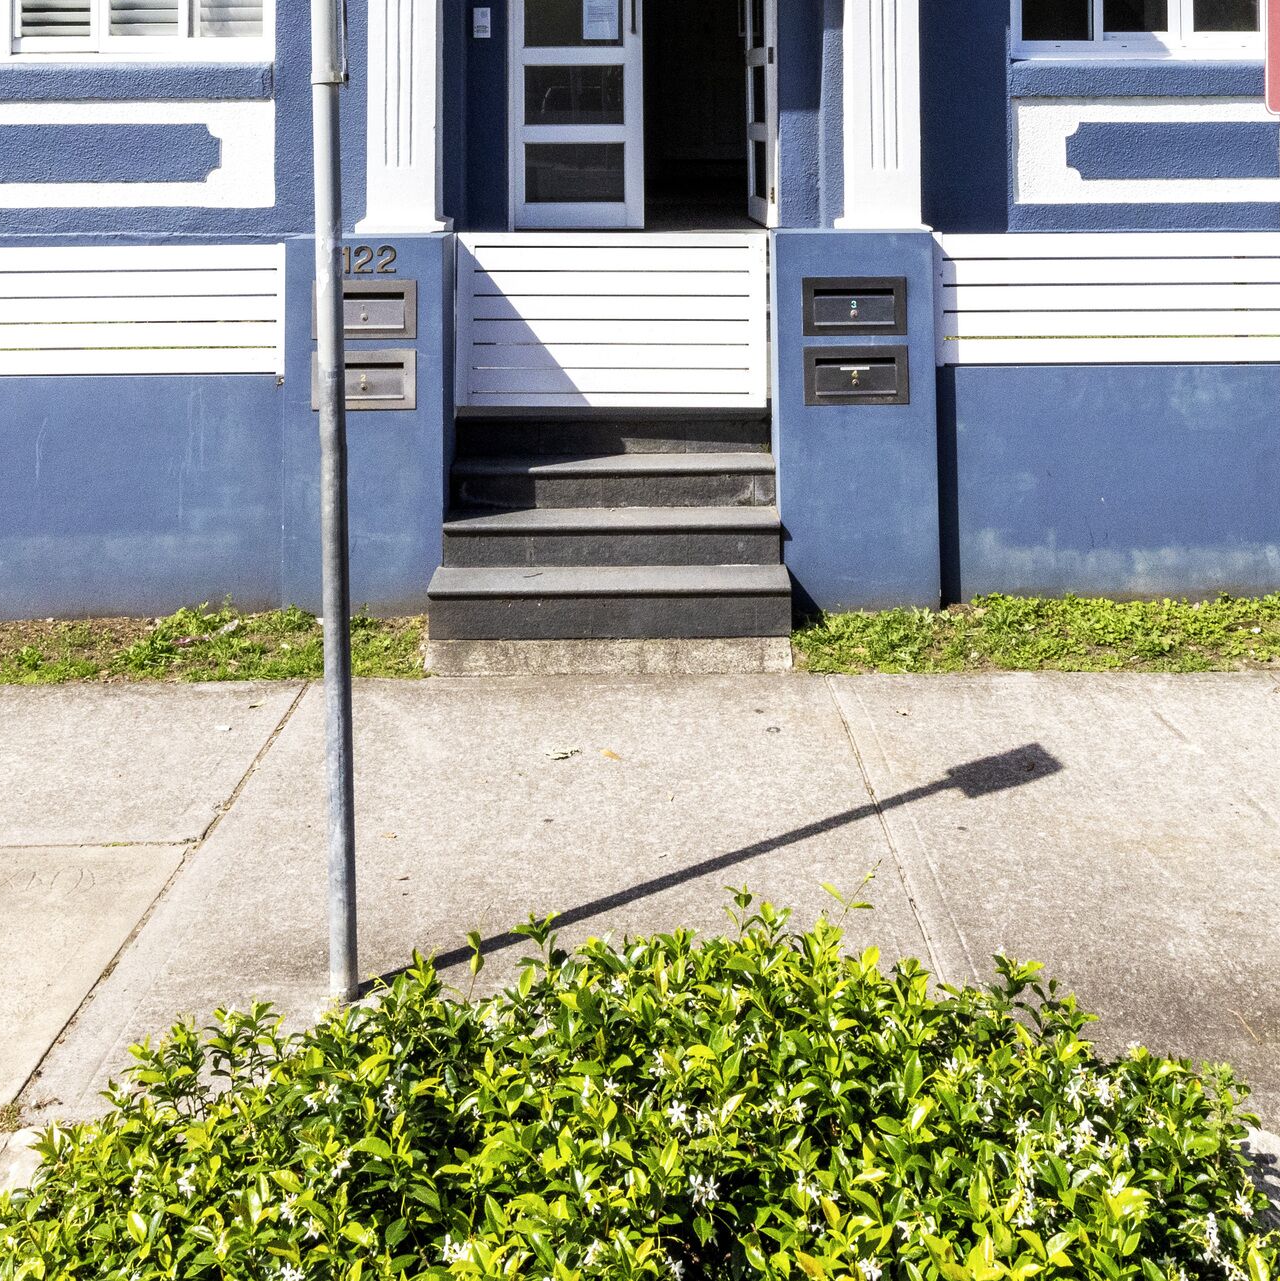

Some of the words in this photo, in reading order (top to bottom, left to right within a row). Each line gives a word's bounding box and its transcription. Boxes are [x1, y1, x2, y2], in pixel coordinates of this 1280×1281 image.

[342, 245, 397, 274] 122
[850, 300, 857, 309] 3
[360, 374, 366, 382] 2
